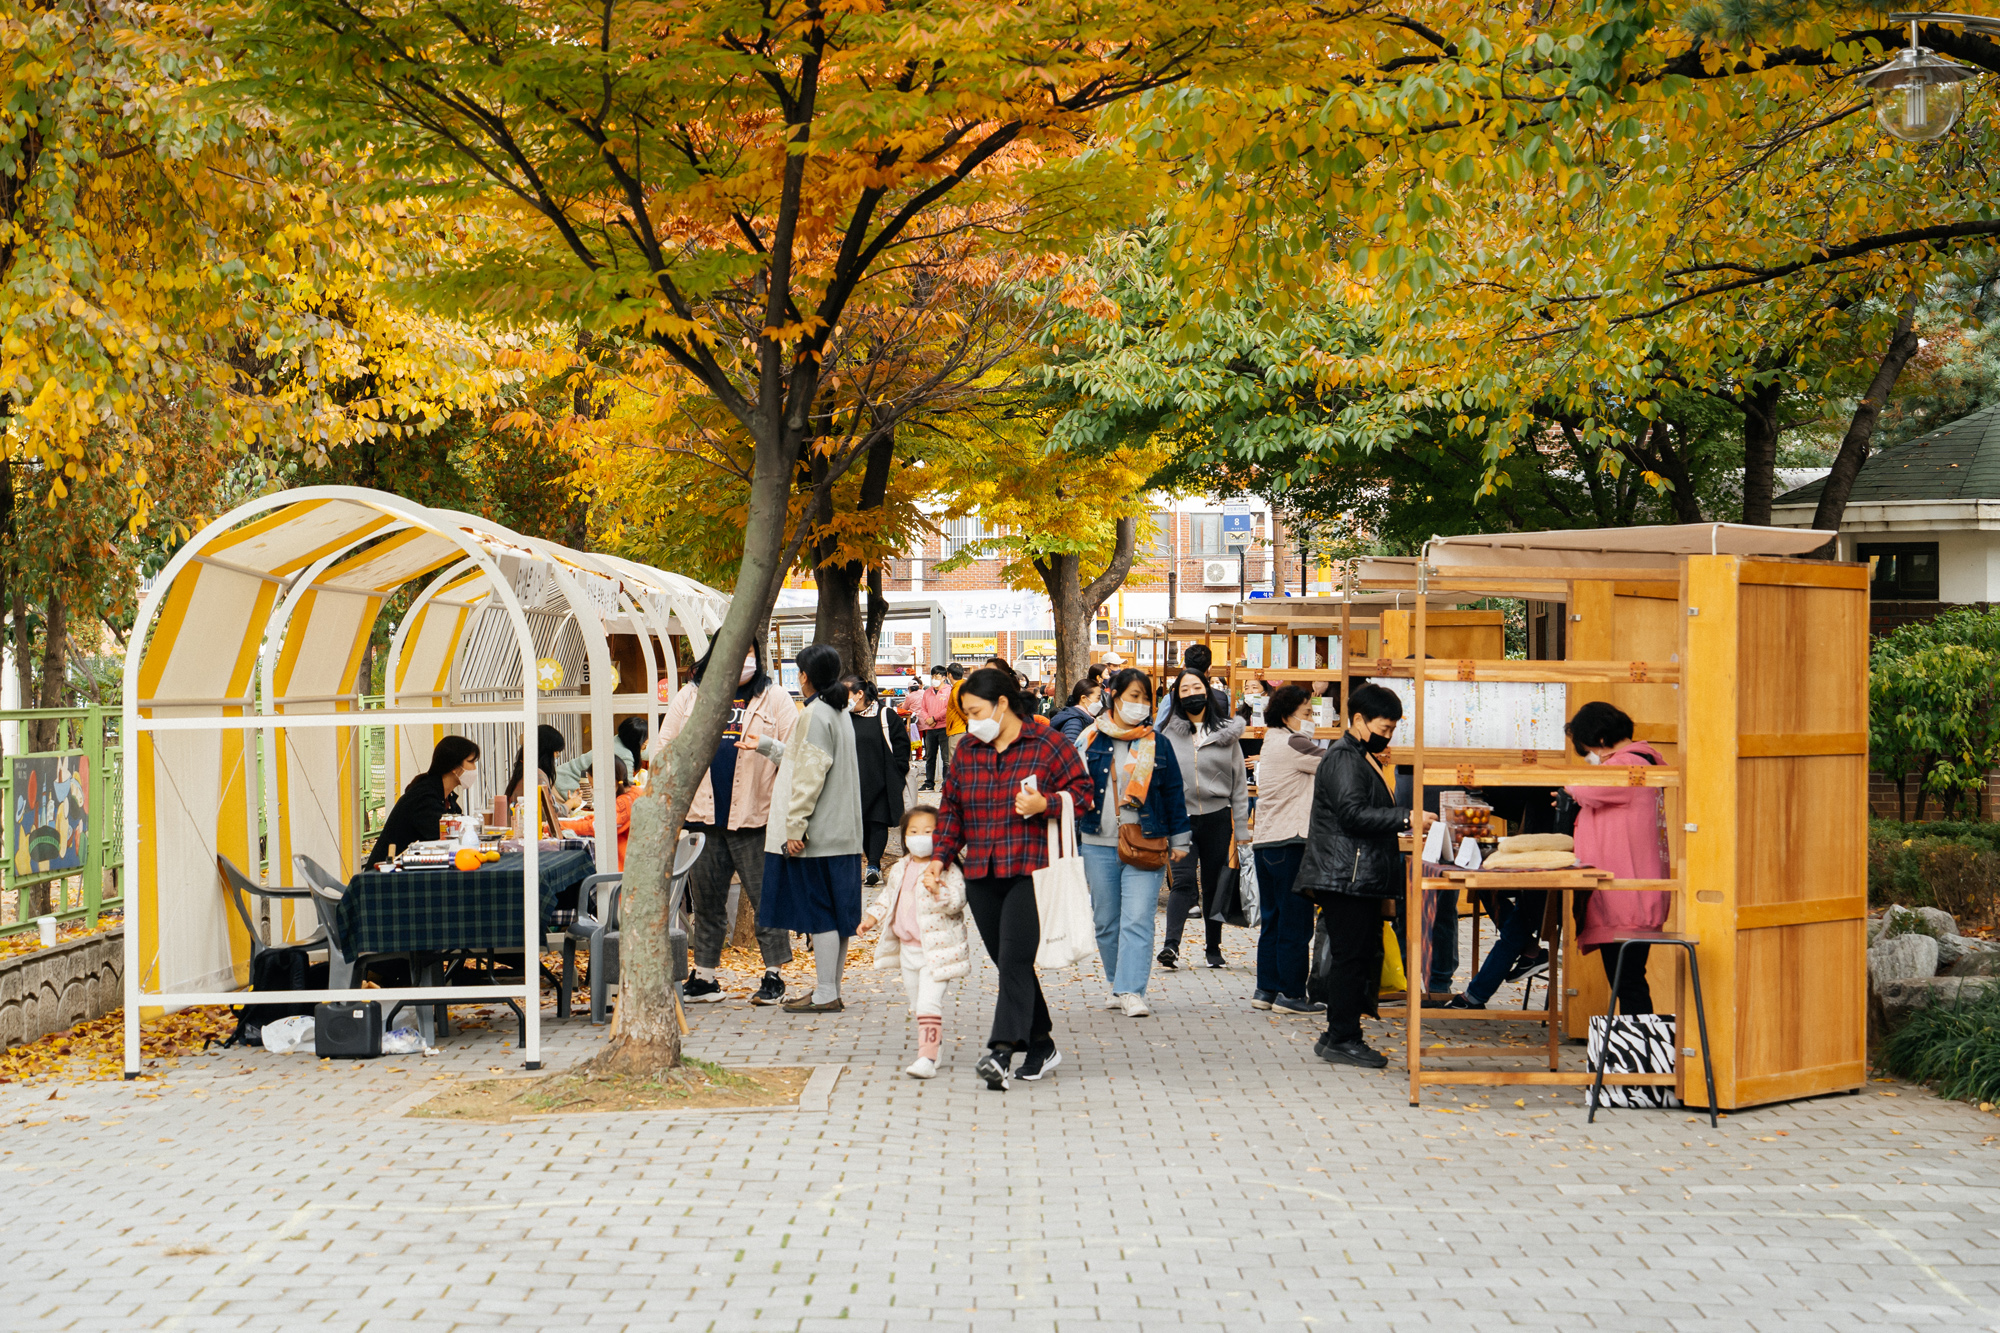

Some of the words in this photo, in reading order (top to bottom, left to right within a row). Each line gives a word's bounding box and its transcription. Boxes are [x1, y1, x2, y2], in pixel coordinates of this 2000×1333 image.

[1234, 517, 1240, 526] 8
[1042, 702, 1051, 714] P
[924, 1026, 937, 1044] 13
